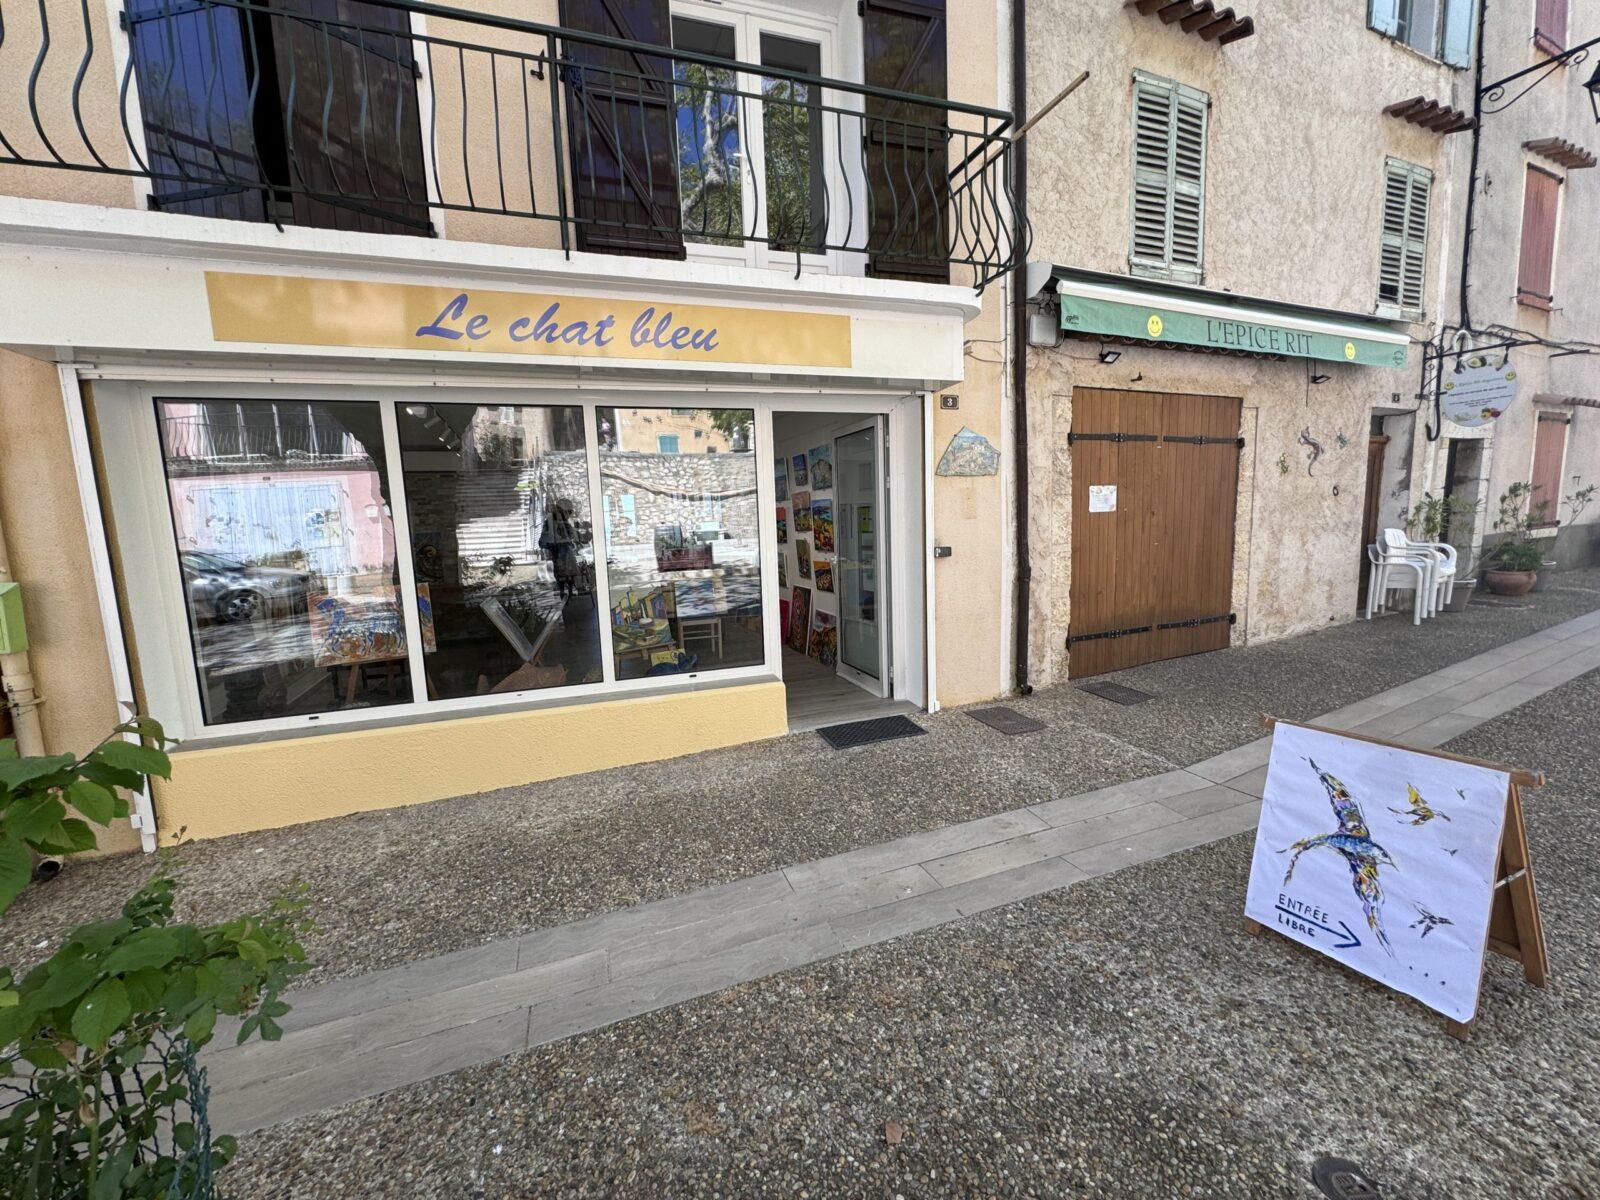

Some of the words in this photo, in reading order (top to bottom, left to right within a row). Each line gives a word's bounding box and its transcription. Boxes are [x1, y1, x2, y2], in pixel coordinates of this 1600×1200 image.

[415, 293, 491, 340] Le
[508, 302, 615, 347] chat
[629, 307, 720, 352] bleu
[1206, 320, 1280, 351] L'EPICE
[1284, 332, 1313, 355] RIT
[1278, 893, 1329, 924] ENTRÉE
[1278, 913, 1316, 938] LIBRE
